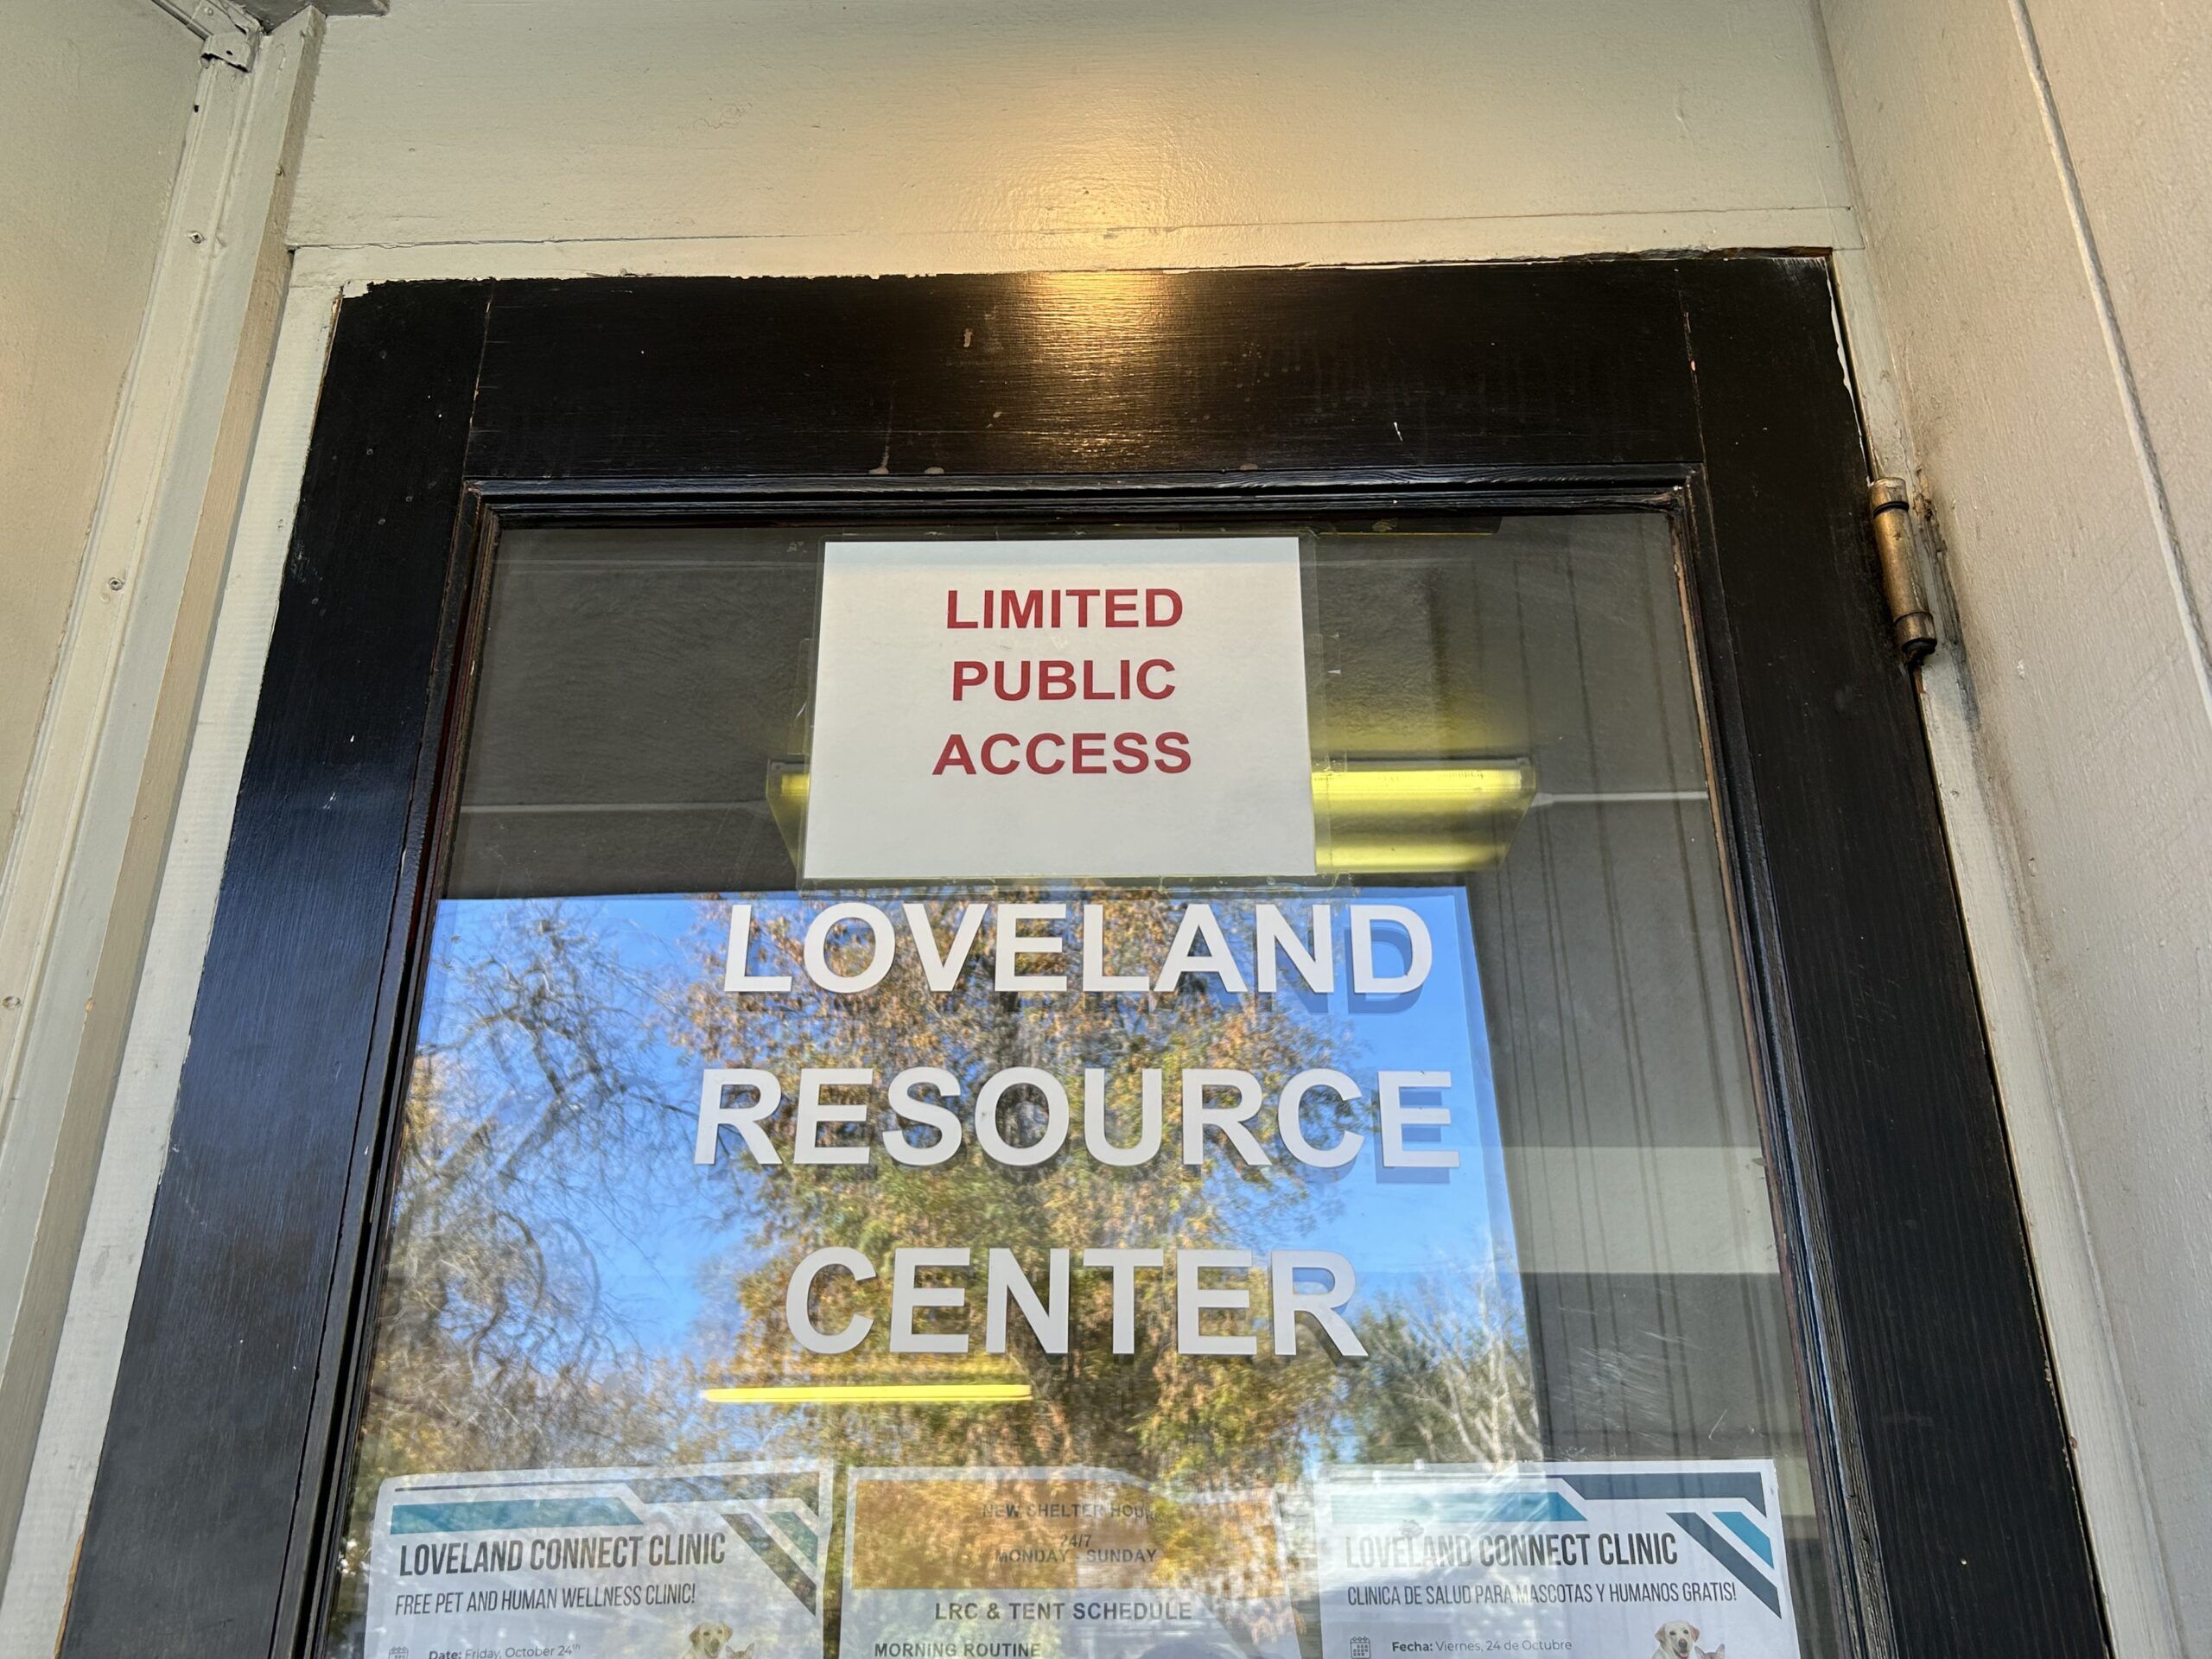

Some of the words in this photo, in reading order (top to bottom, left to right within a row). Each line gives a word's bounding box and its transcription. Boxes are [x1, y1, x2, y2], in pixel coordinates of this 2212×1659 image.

[946, 588, 1183, 629] LIMITED
[952, 658, 1176, 702] PUBLIC
[932, 731, 1192, 776] ACCESS
[723, 902, 1433, 994] LOVELAND
[694, 1066, 1461, 1167] RESOURCE
[785, 1246, 1369, 1357] CENTER
[982, 1503, 1020, 1518] NEW
[1027, 1503, 1104, 1518] SHELTER
[399, 1539, 524, 1577] LOVELAND
[530, 1535, 644, 1572] CONNECT
[649, 1532, 726, 1567] CLINIC
[995, 1548, 1069, 1563] MONDAY
[1086, 1548, 1158, 1563] SUNDAY
[1061, 1534, 1093, 1548] 24/7
[1345, 1534, 1472, 1568] LOVELAND
[1479, 1533, 1591, 1567] CONNECT
[1598, 1532, 1678, 1565] CLINIC
[395, 1594, 431, 1616] FREE
[435, 1592, 464, 1614] PET
[467, 1590, 498, 1611] AND
[501, 1588, 558, 1610] HUMAN
[562, 1585, 641, 1609] WELLNESS
[645, 1583, 696, 1605] CLINIC!
[1347, 1586, 1402, 1605] CLINICA
[1404, 1586, 1423, 1605] DE
[1426, 1585, 1471, 1605] SALUD
[1475, 1584, 1514, 1604] PARA
[1516, 1583, 1593, 1604] MASCOTAS
[1595, 1583, 1607, 1602] Y
[1610, 1582, 1680, 1603] HUMANOS
[1683, 1581, 1737, 1602] GRATIS!
[935, 1602, 979, 1621] LRC
[987, 1602, 1002, 1620] &
[1008, 1602, 1065, 1620] TENT
[1072, 1602, 1192, 1621] SCHEDULE
[429, 1649, 462, 1659] Date:
[465, 1648, 503, 1659] Friday,
[505, 1645, 555, 1658] October
[874, 1643, 957, 1657] MORNING
[963, 1643, 1042, 1657] ROUTINE
[1392, 1641, 1433, 1652] Fecha:
[1435, 1640, 1484, 1653] Viernes,
[1485, 1641, 1502, 1651] 24
[1503, 1640, 1519, 1651] de
[1521, 1639, 1573, 1651] Octubre
